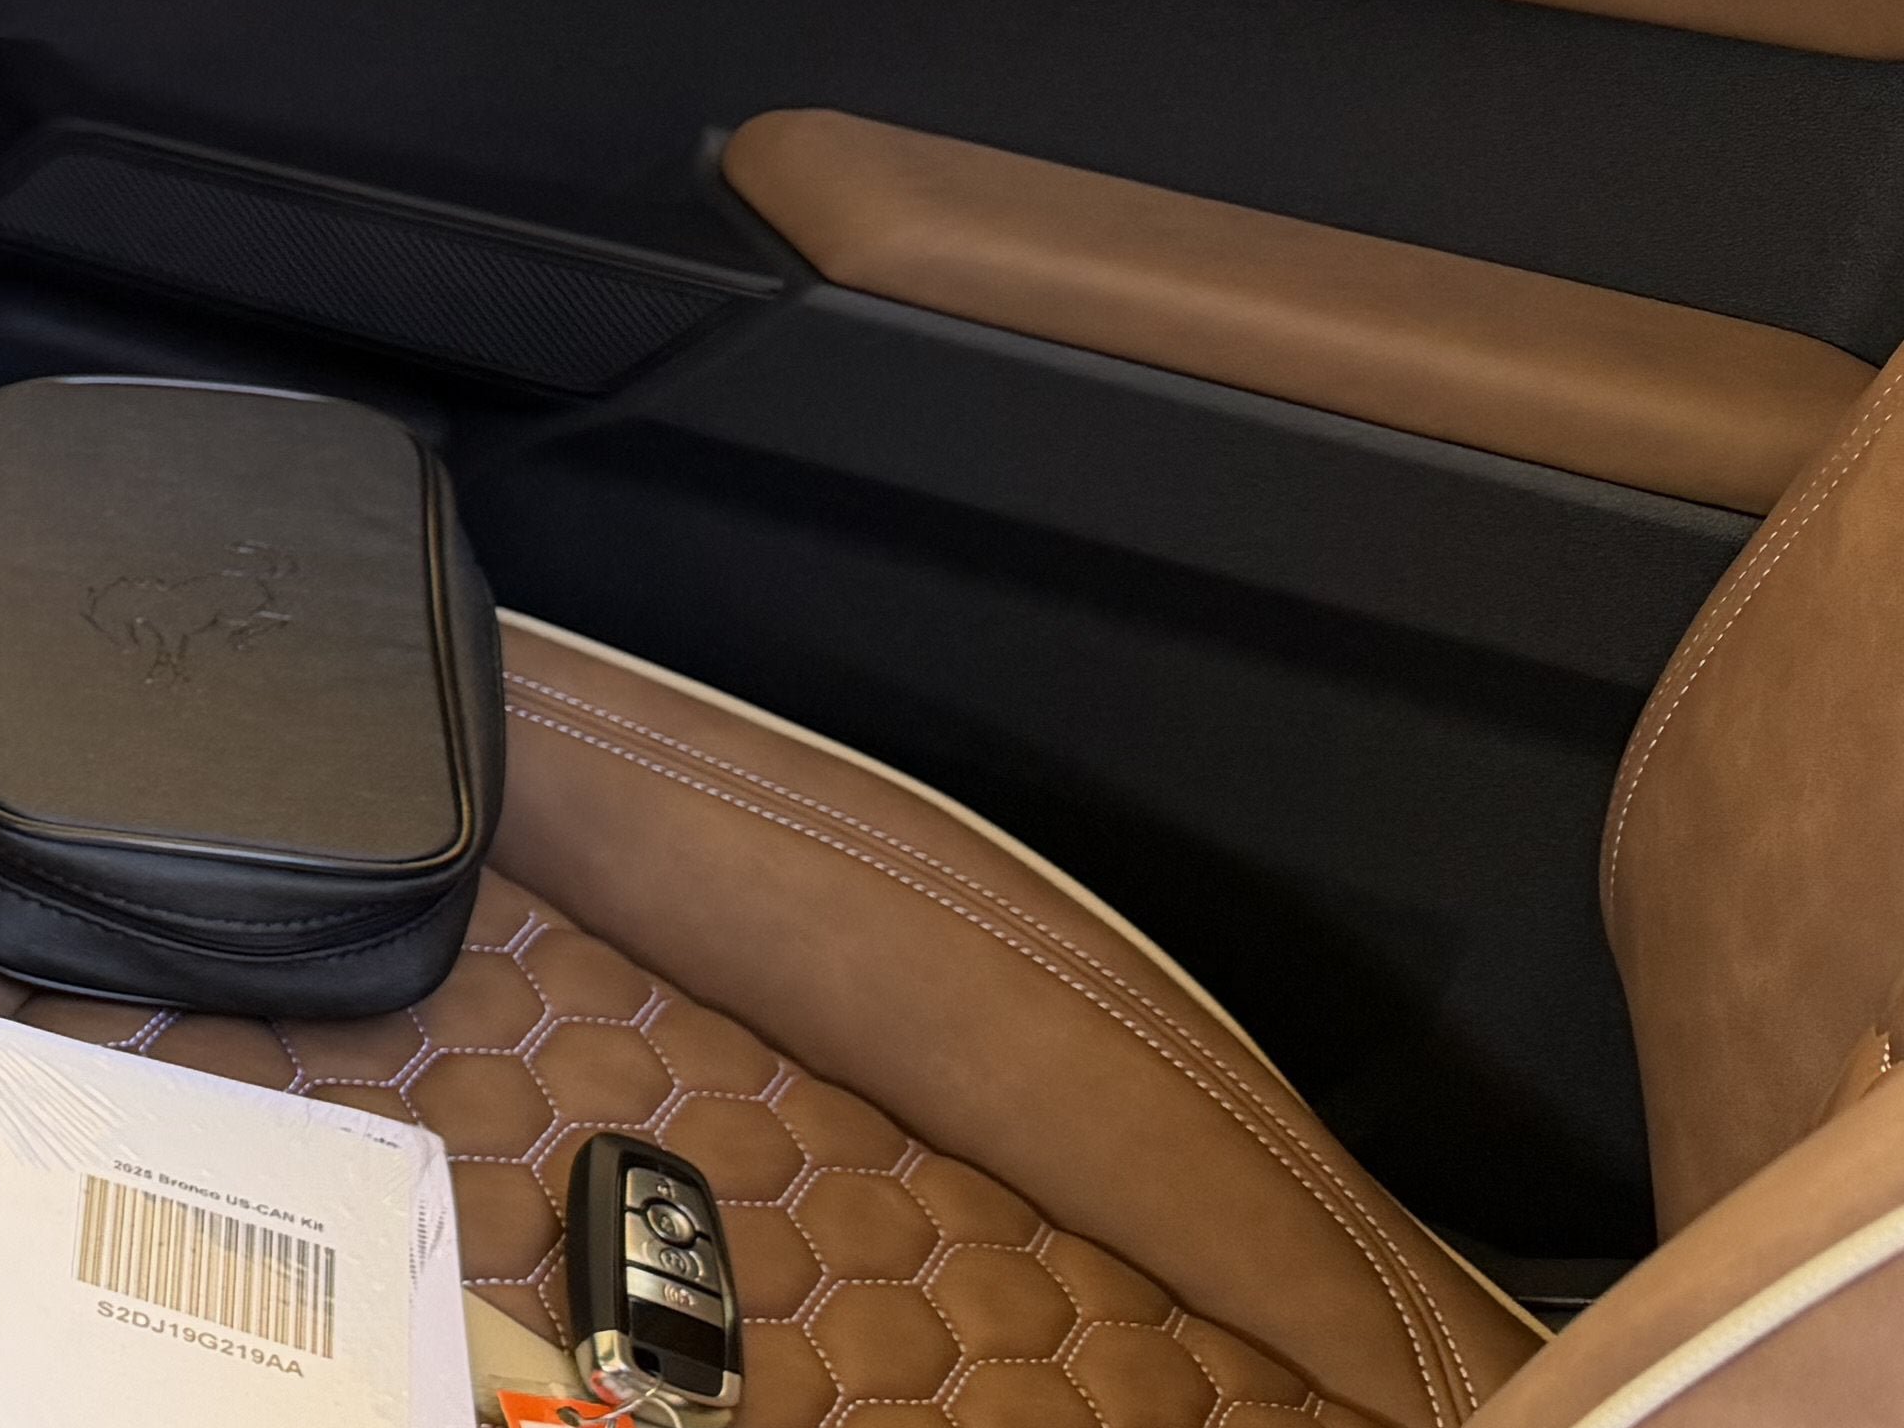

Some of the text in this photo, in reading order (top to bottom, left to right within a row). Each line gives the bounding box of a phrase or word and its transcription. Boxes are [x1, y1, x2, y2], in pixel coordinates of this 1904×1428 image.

[158, 1171, 221, 1201] Bronco
[225, 1192, 296, 1223] US-CAN
[301, 1217, 326, 1234] Kit
[96, 1298, 305, 1379] S2DJ19G219AA
